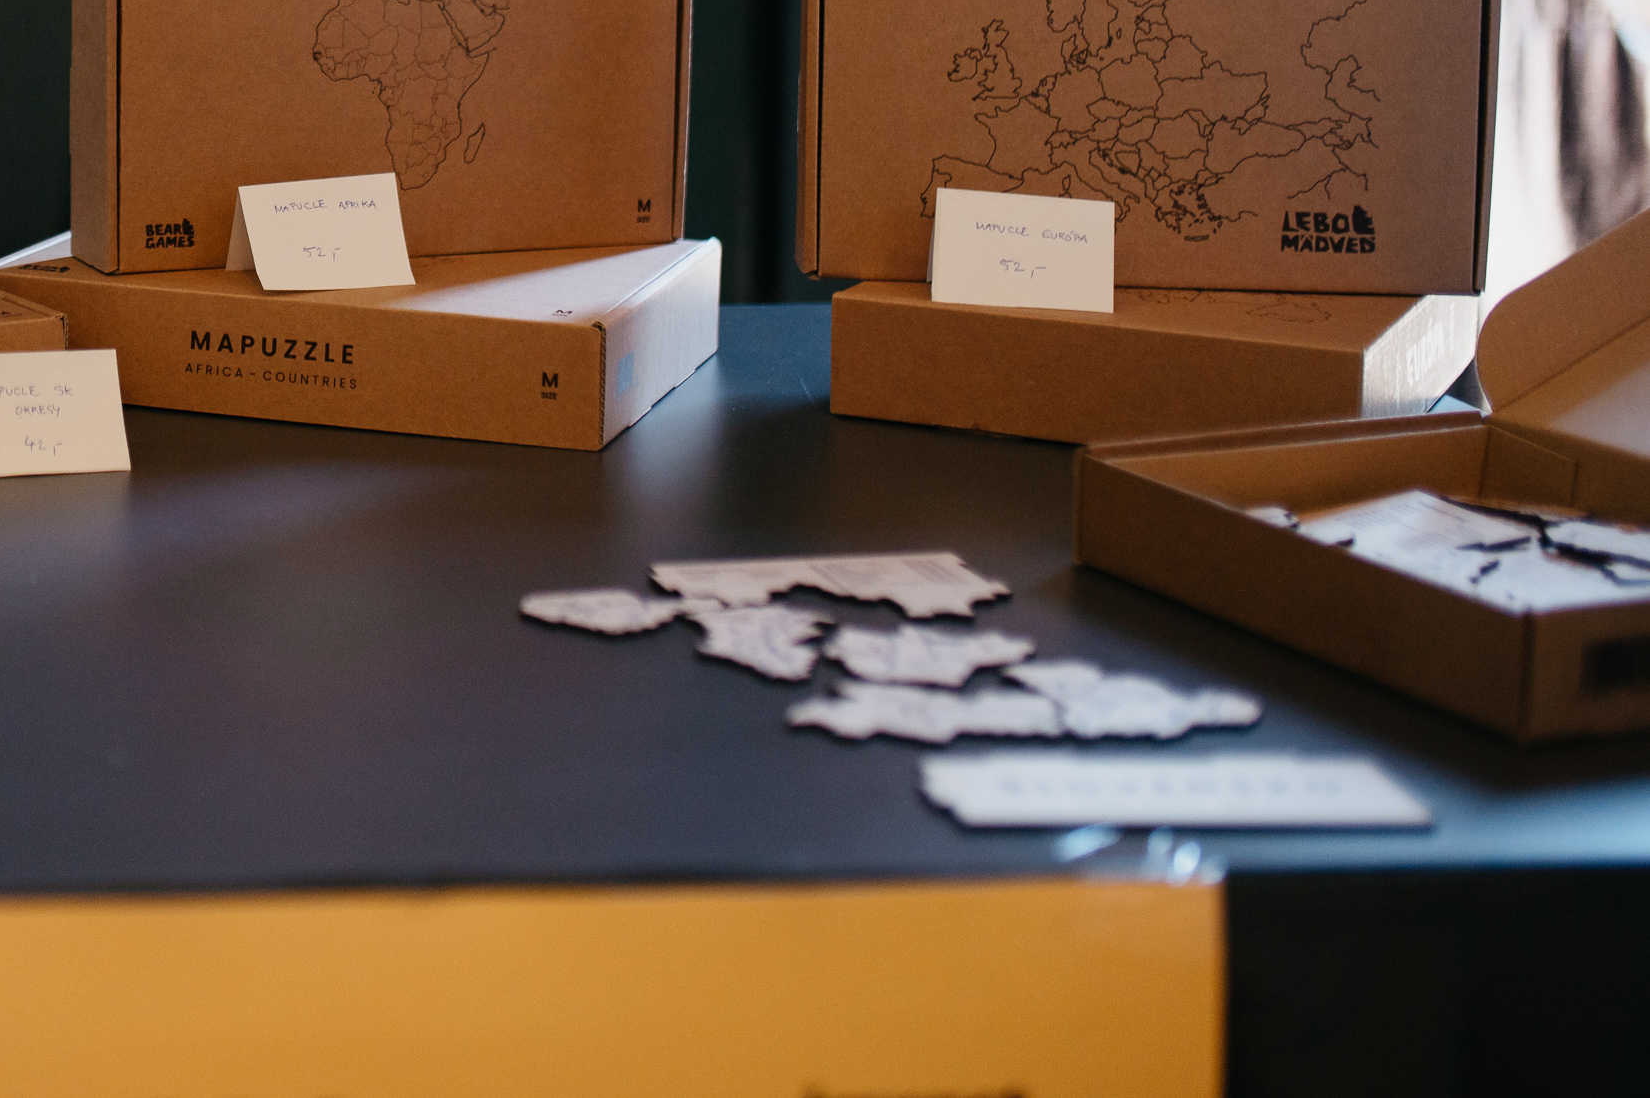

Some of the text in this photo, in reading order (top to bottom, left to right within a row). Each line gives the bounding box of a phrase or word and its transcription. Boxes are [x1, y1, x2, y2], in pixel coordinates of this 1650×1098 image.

[274, 199, 377, 213] MAPUCLE AFRIKA
[637, 199, 651, 213] M
[1282, 210, 1350, 234] LEBO
[145, 224, 183, 237] BEAR
[145, 236, 195, 249] GAMES
[190, 330, 354, 365] MAPUZZLE
[185, 363, 243, 378] AFRICA
[262, 370, 357, 390] COUNTRIES
[541, 372, 559, 388] M
